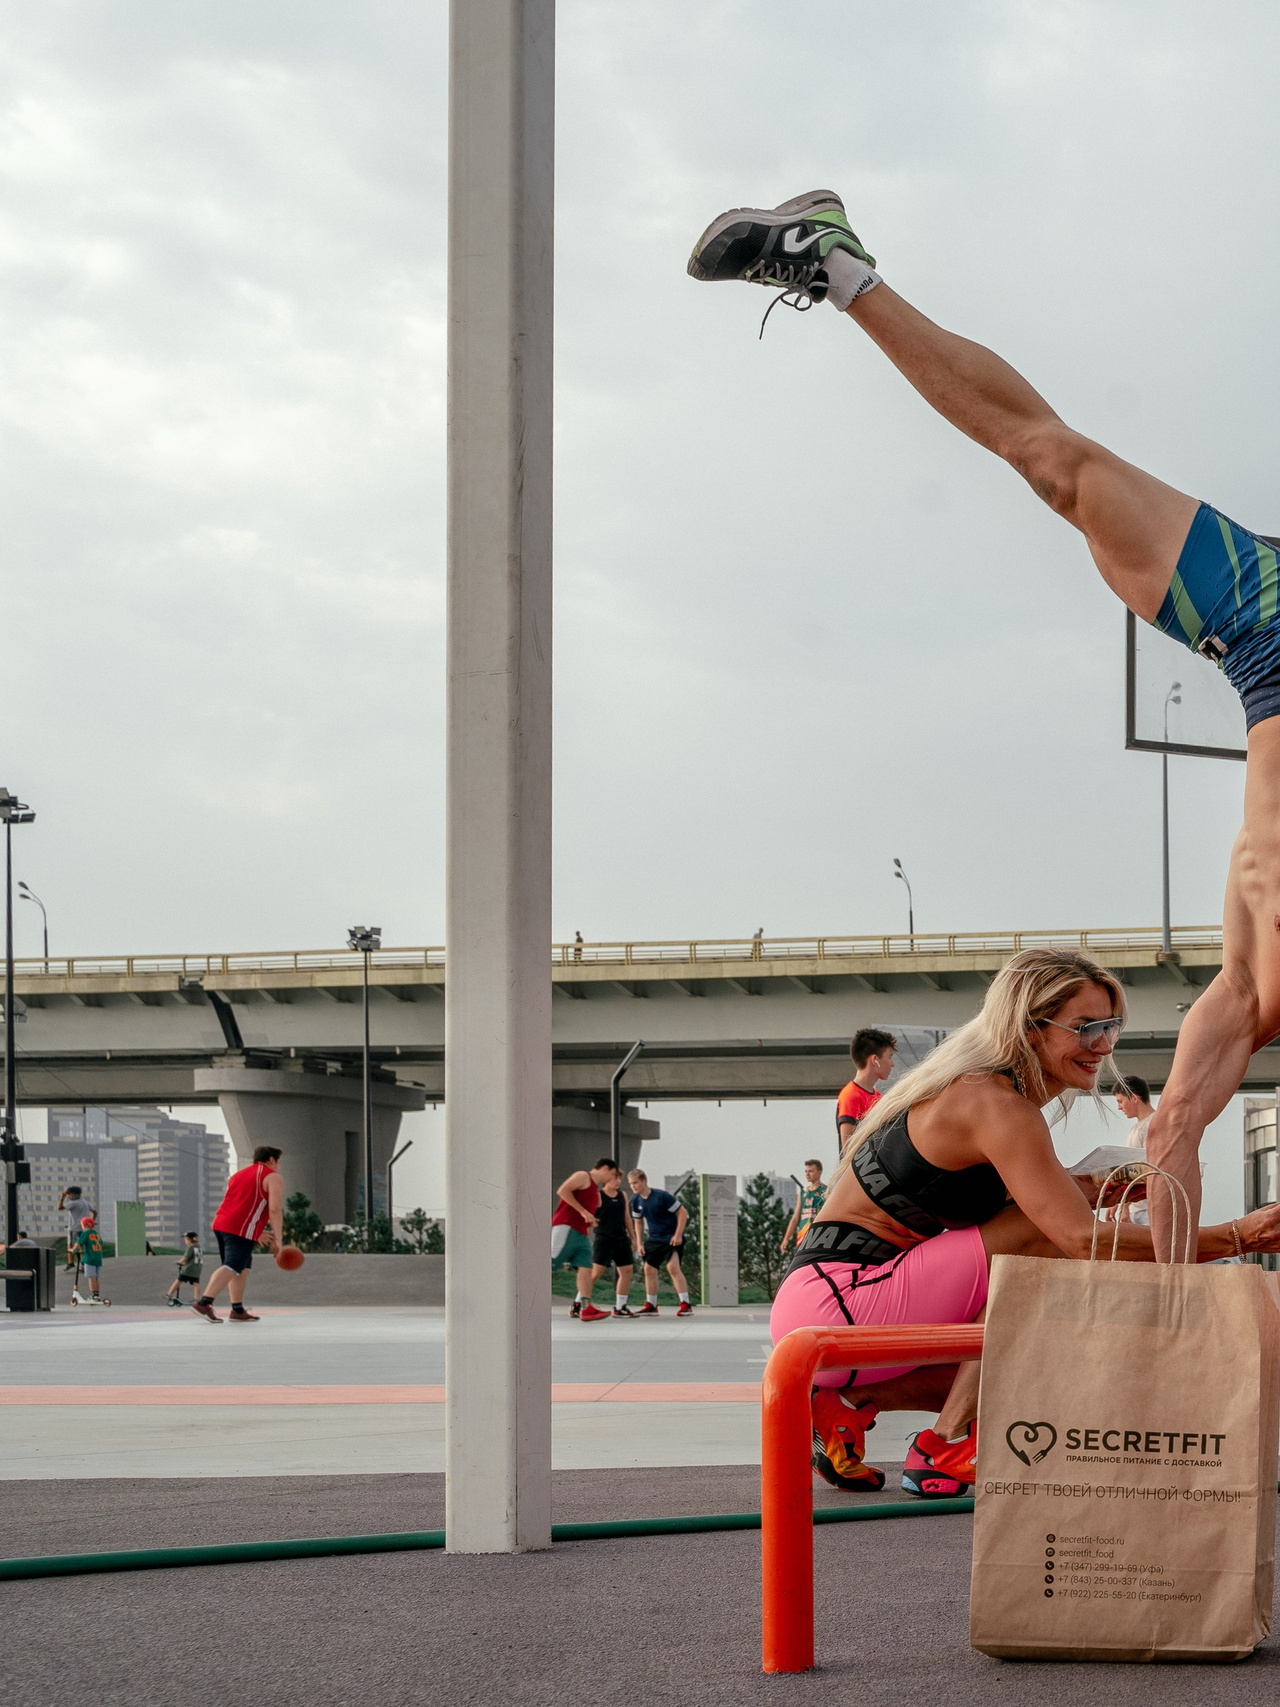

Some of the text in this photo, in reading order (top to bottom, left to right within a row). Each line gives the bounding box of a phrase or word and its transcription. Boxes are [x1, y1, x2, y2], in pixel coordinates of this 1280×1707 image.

[1065, 1428, 1226, 1456] SECRETFIT
[1066, 1455, 1121, 1464] ПРАВИЛЬНОЕ
[1123, 1457, 1162, 1466] ПИТАНИЕ
[1171, 1458, 1223, 1468] ДОСТАВКОЙ
[984, 1481, 1241, 1503] СЕКРЕТ ТВОЕЙ ОТЛИЧНОЙ ФОРМЫ!
[1059, 1535, 1125, 1545] secretfit-food.ru
[1059, 1549, 1114, 1559] secretfit_food
[1058, 1561, 1164, 1575] +7 (347) 299-19-69 (Уфа)
[1058, 1575, 1176, 1589] +7 (843) 25-00-337 (Казань)
[1057, 1589, 1202, 1603] +7 (922) 225-55-20 (Екатеринбург)
